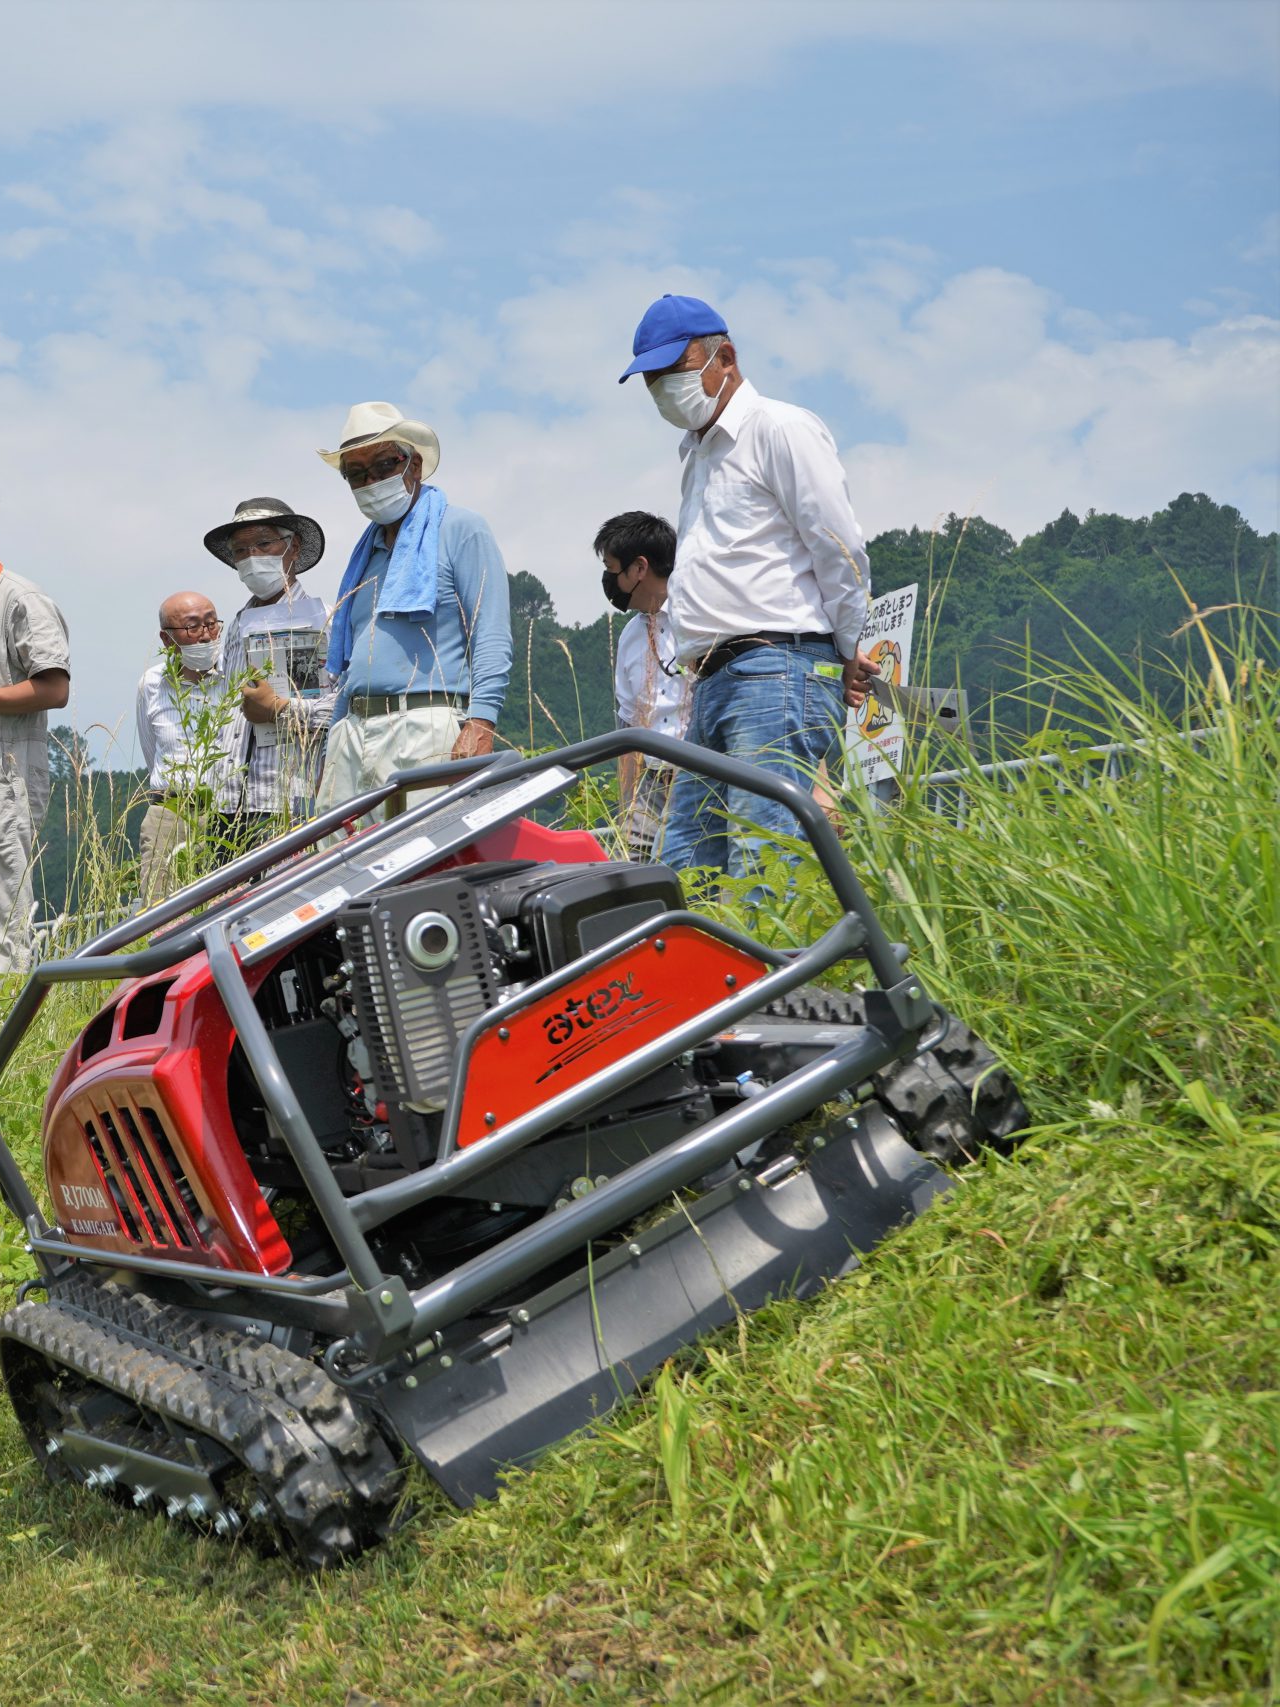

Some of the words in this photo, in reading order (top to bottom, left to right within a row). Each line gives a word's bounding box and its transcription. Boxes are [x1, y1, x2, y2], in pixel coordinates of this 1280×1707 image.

[542, 971, 644, 1045] atex
[60, 1184, 108, 1210] RJ700A
[71, 1218, 118, 1237] KAMIGARI
